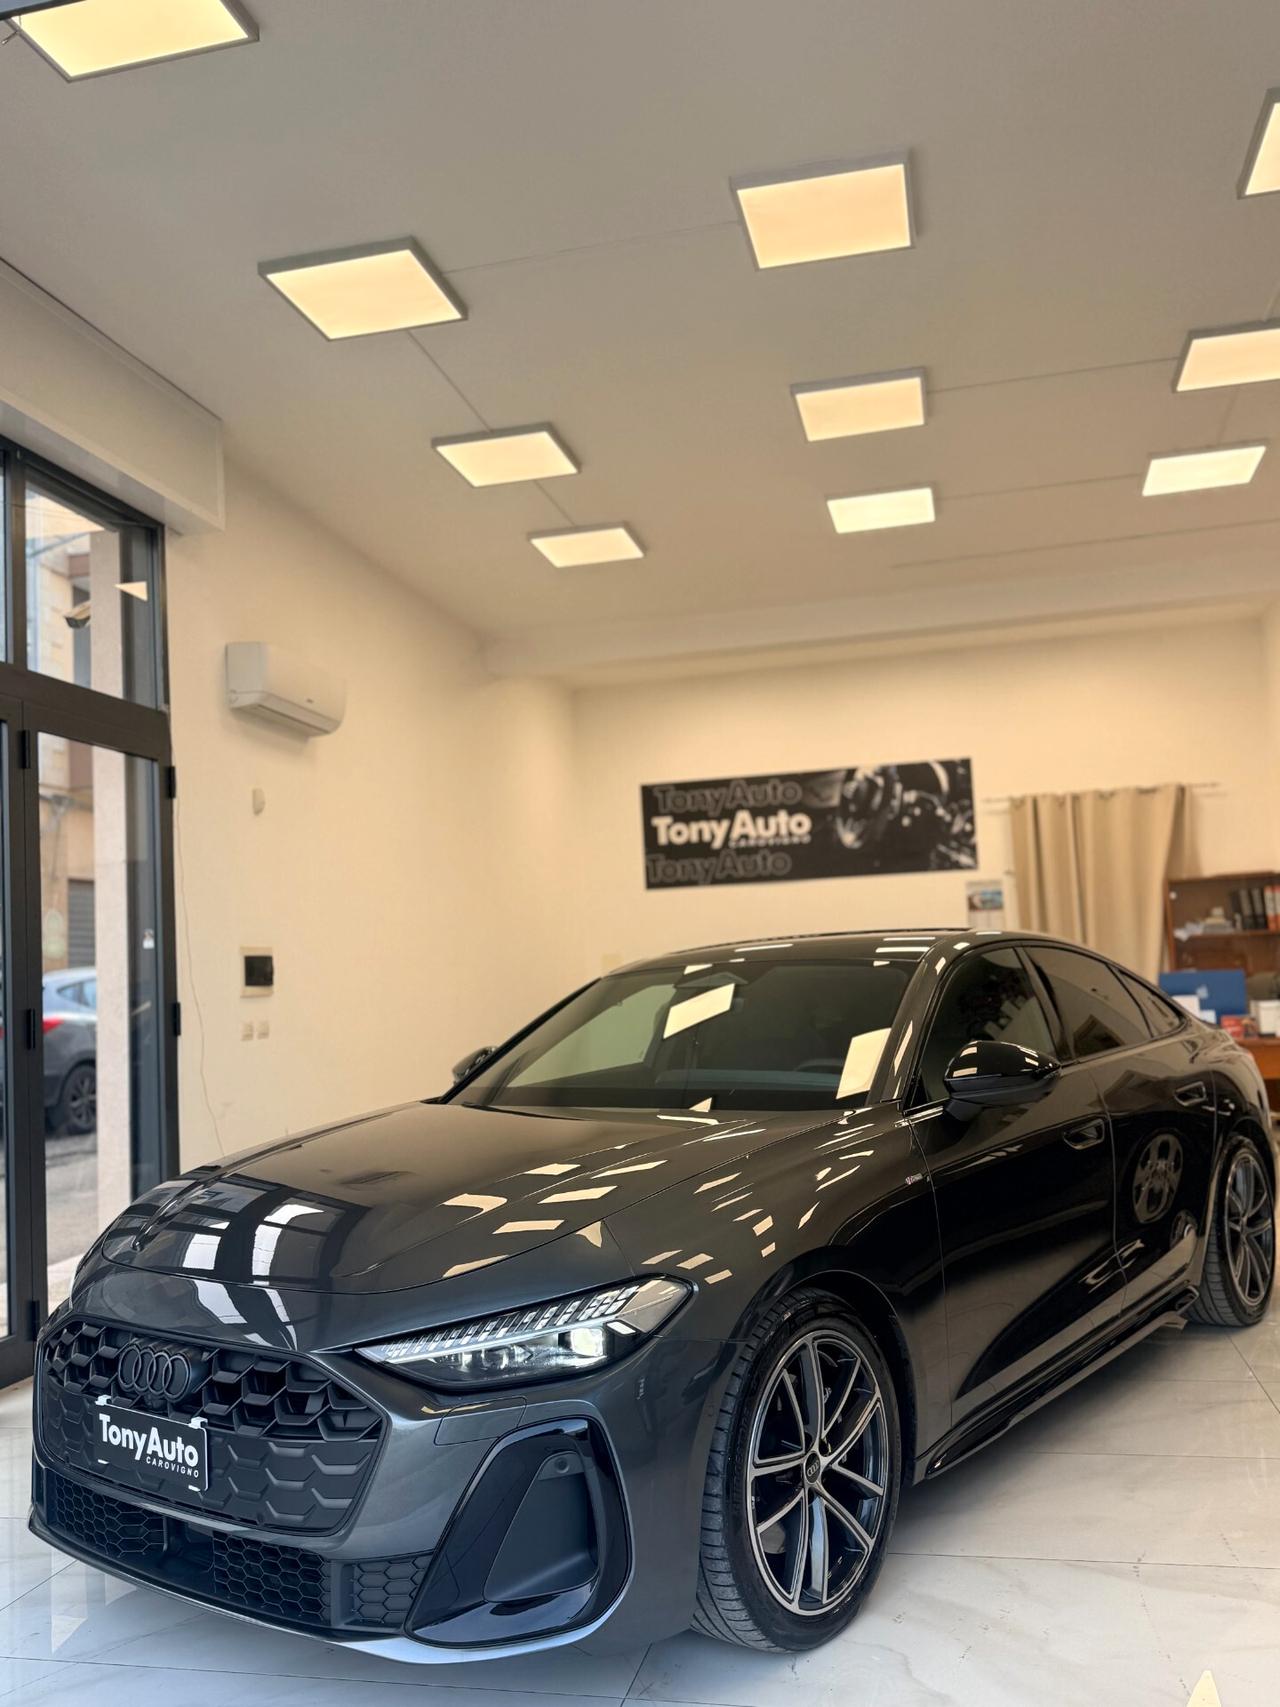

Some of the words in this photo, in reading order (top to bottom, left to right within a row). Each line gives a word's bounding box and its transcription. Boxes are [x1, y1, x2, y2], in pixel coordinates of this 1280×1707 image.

[652, 778, 803, 817] TonyAuto
[651, 809, 812, 849] TonyAuto
[99, 1413, 199, 1467] TonyAuto
[145, 1456, 199, 1478] CAROVIGNO
